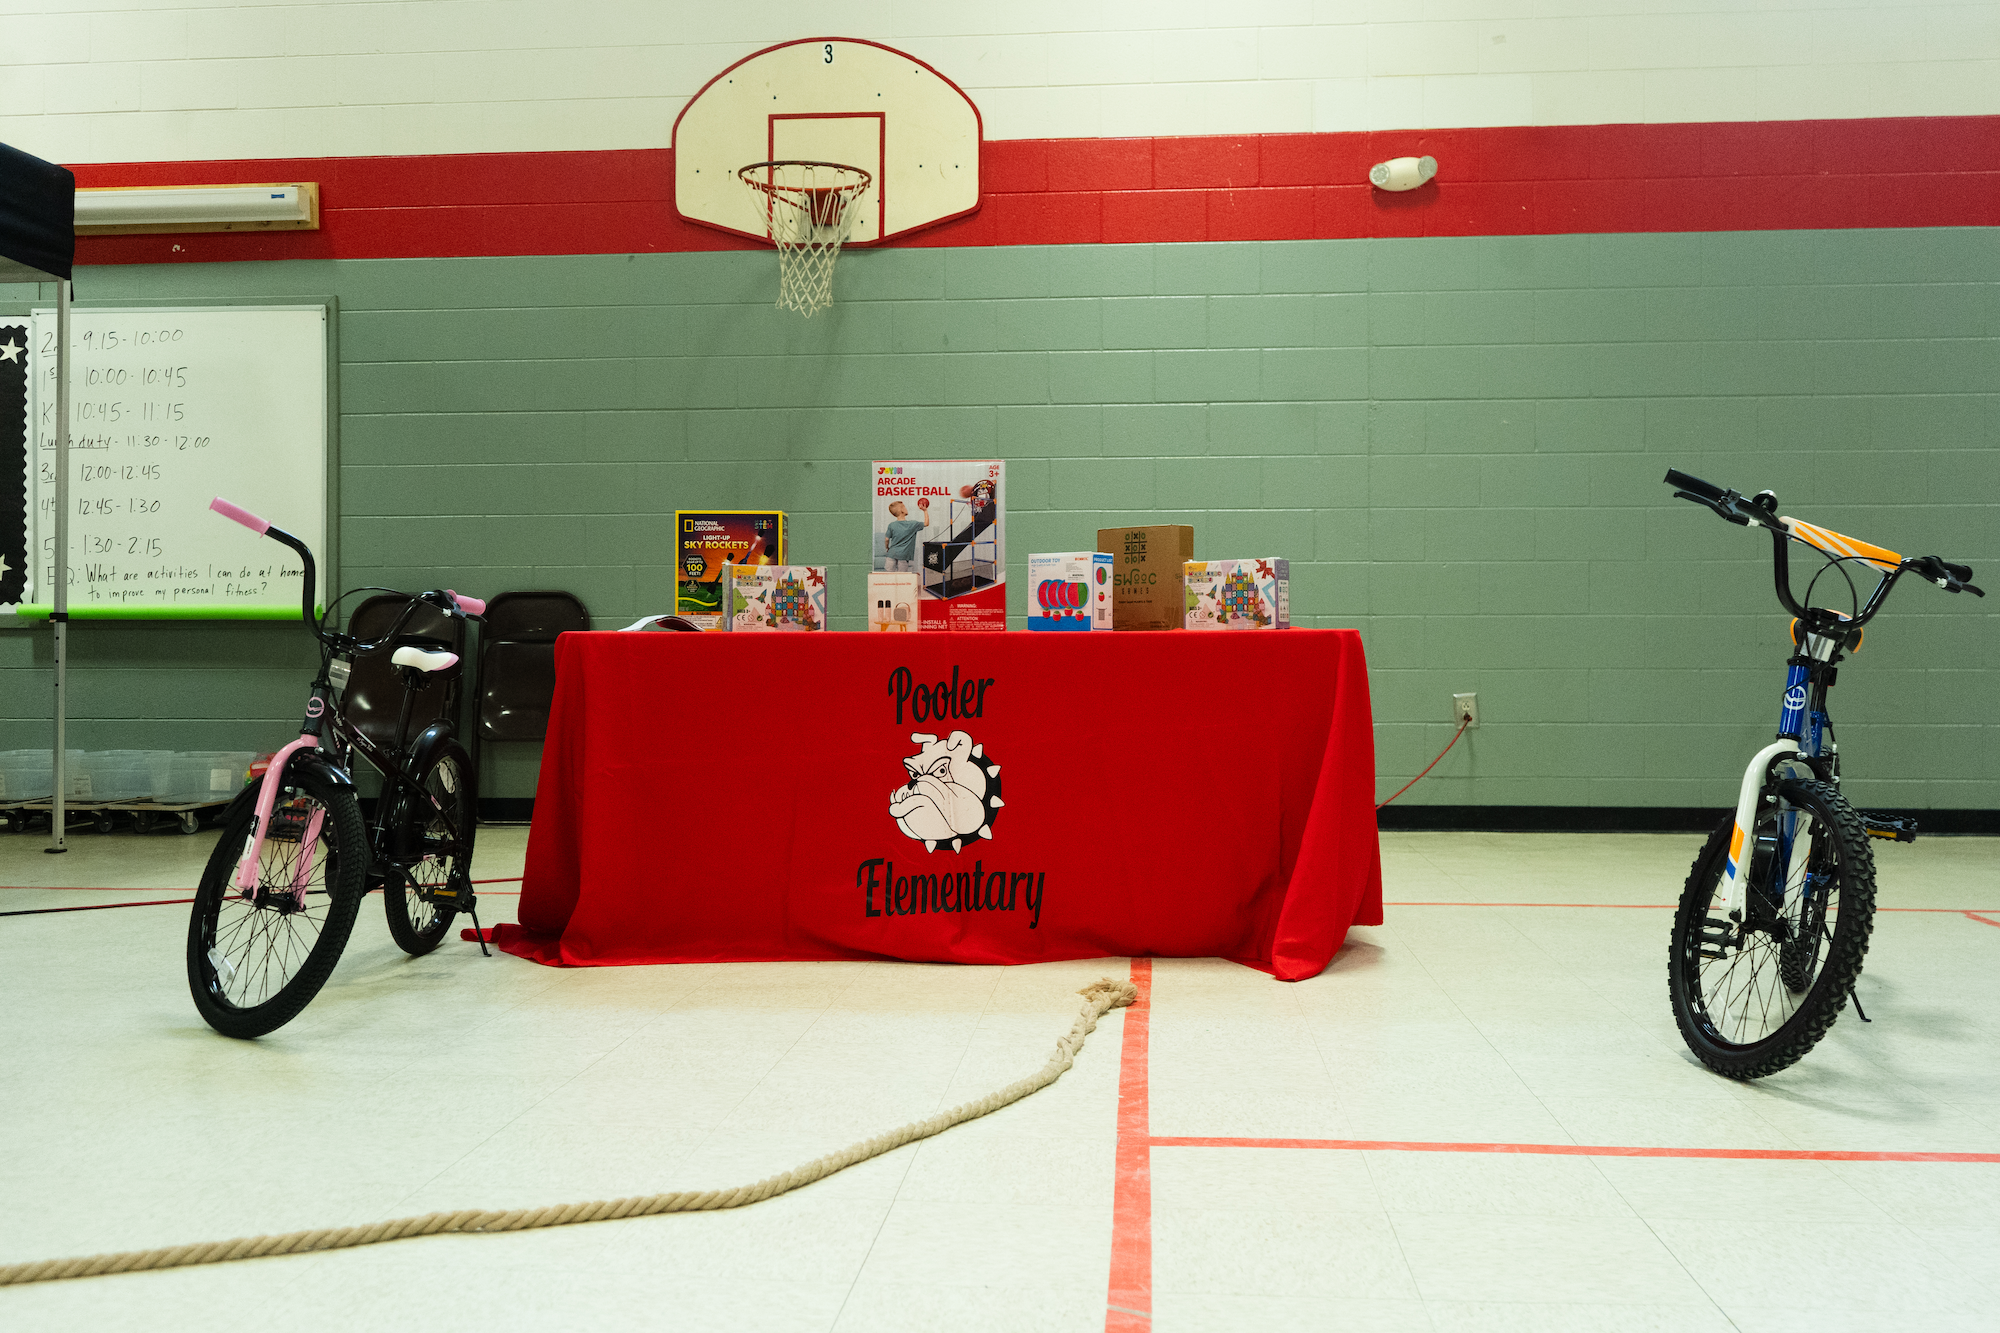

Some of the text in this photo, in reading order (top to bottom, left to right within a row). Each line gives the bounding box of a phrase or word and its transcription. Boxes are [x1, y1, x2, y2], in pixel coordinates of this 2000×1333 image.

[824, 44, 833, 63] 3
[142, 366, 188, 388] 10:45
[77, 402, 122, 422] 10:45
[40, 432, 74, 448] Luh
[78, 433, 112, 452] duty
[877, 466, 903, 475] JOYIN
[877, 477, 916, 485] ARCADE
[877, 486, 951, 496] BASKETBALL
[684, 541, 749, 549] SKY ROCKETS
[86, 563, 117, 583] What
[123, 572, 139, 581] are
[147, 565, 198, 579] activities
[217, 570, 232, 578] can
[239, 565, 251, 579] do
[258, 565, 272, 578] at
[279, 564, 305, 578] home
[686, 564, 703, 572] 100
[1114, 568, 1157, 586] SWOOC
[88, 581, 268, 603] to improve my personal fitness?
[888, 665, 995, 724] Pooler
[856, 857, 1046, 929] Elementary
